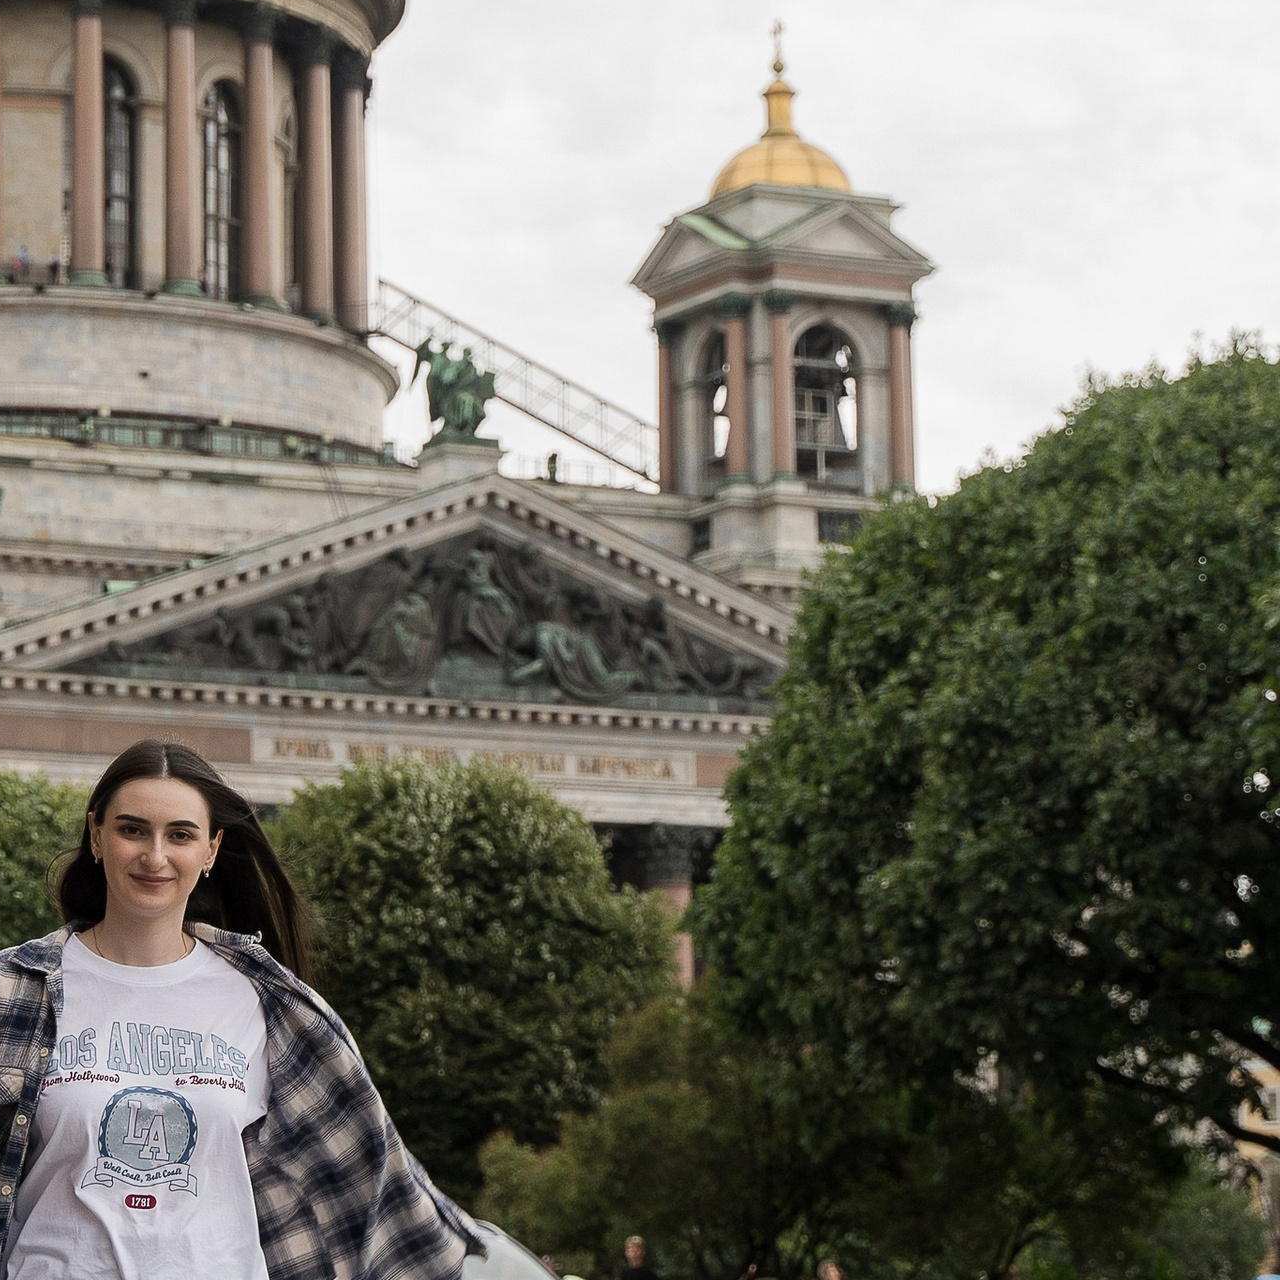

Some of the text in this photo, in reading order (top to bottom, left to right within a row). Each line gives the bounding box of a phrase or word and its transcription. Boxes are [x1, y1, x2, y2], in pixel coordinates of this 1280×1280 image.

[106, 1021, 248, 1080] ANGELES
[41, 1076, 64, 1092] from
[64, 1070, 120, 1084] Hollywood
[175, 1077, 187, 1087] to
[189, 1075, 227, 1089] Beverly
[123, 1100, 171, 1161] LA
[131, 1196, 151, 1208] 1781
